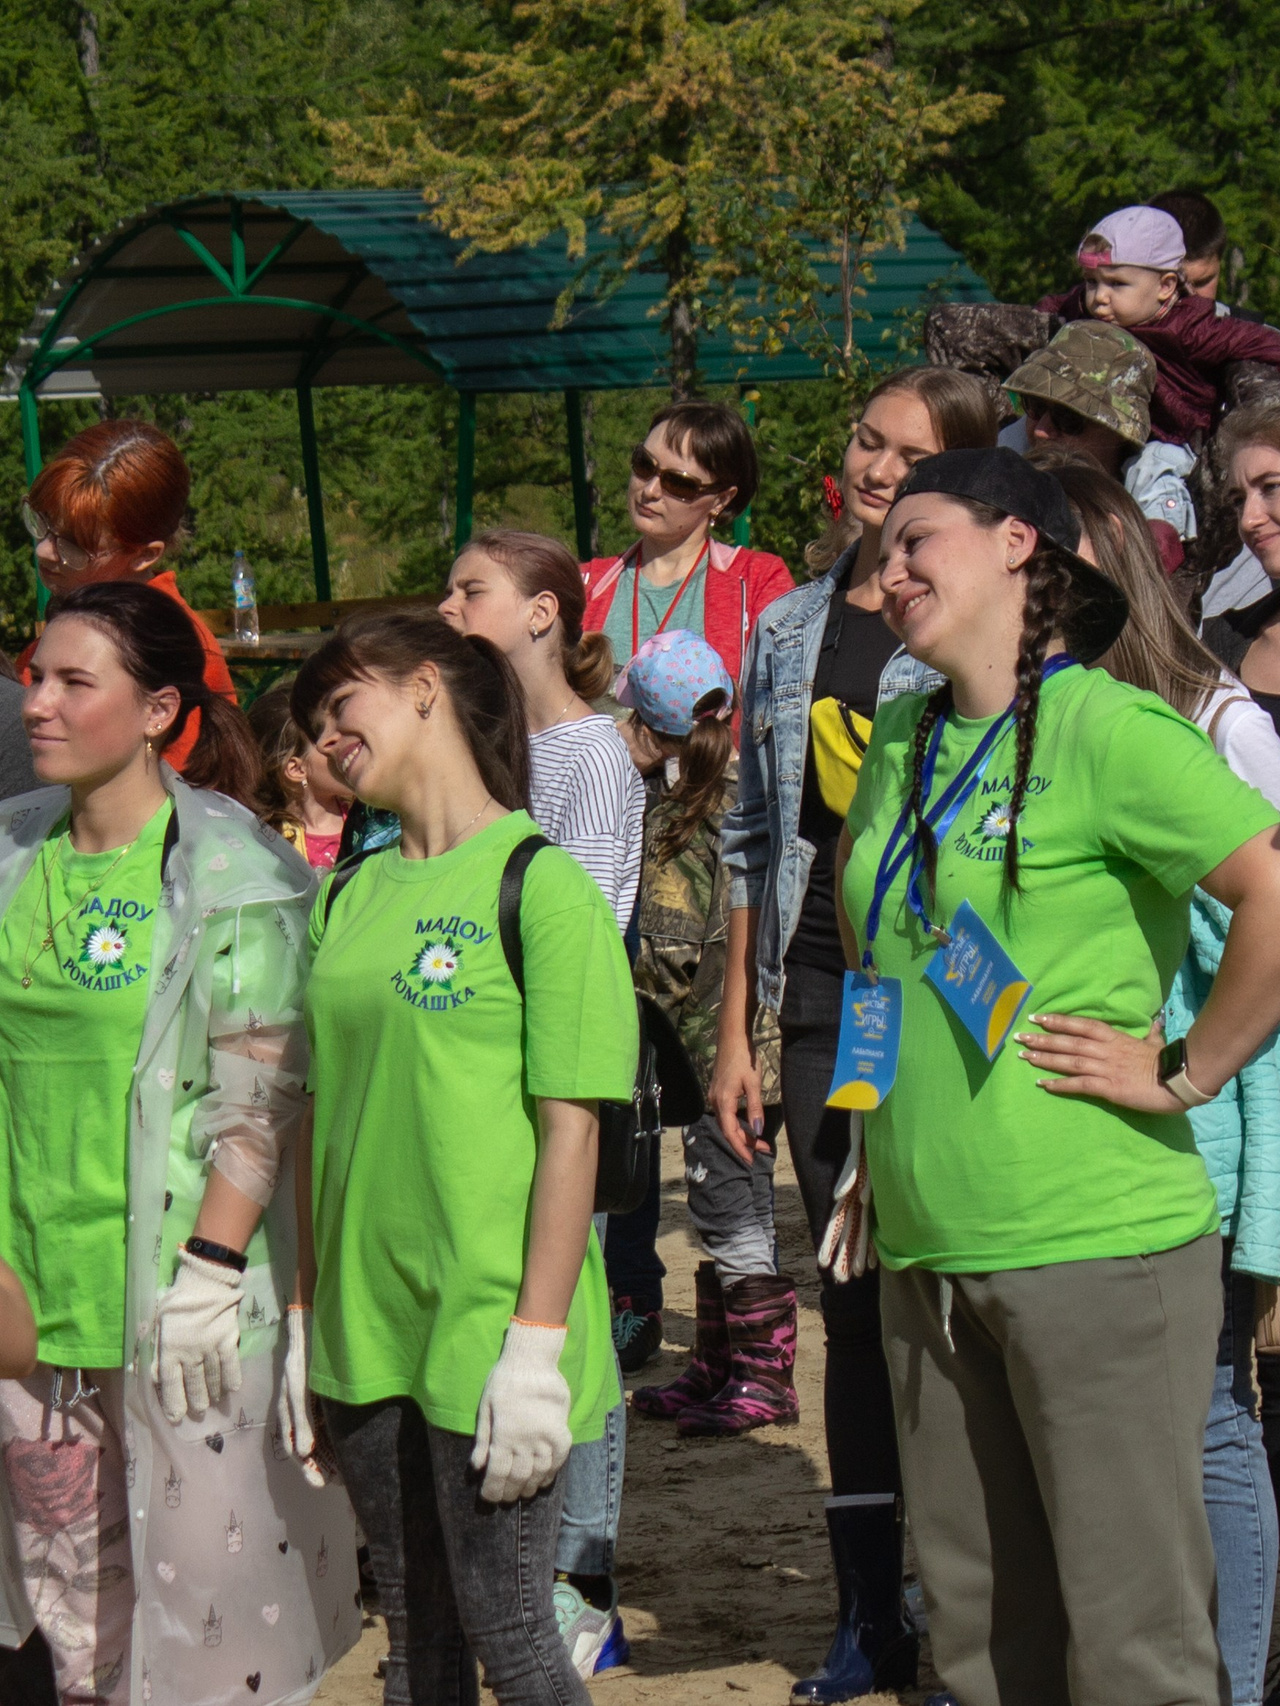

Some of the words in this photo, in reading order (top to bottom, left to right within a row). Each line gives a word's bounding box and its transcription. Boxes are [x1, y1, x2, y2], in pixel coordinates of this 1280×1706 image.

[981, 775, 1052, 795] МАОУ
[954, 832, 1035, 861] РОМАША
[414, 915, 492, 944] МАДОУ
[62, 956, 148, 991] РОМАШКА
[957, 945, 976, 978] ИГРЫ
[390, 969, 476, 1011] РОМАШКА
